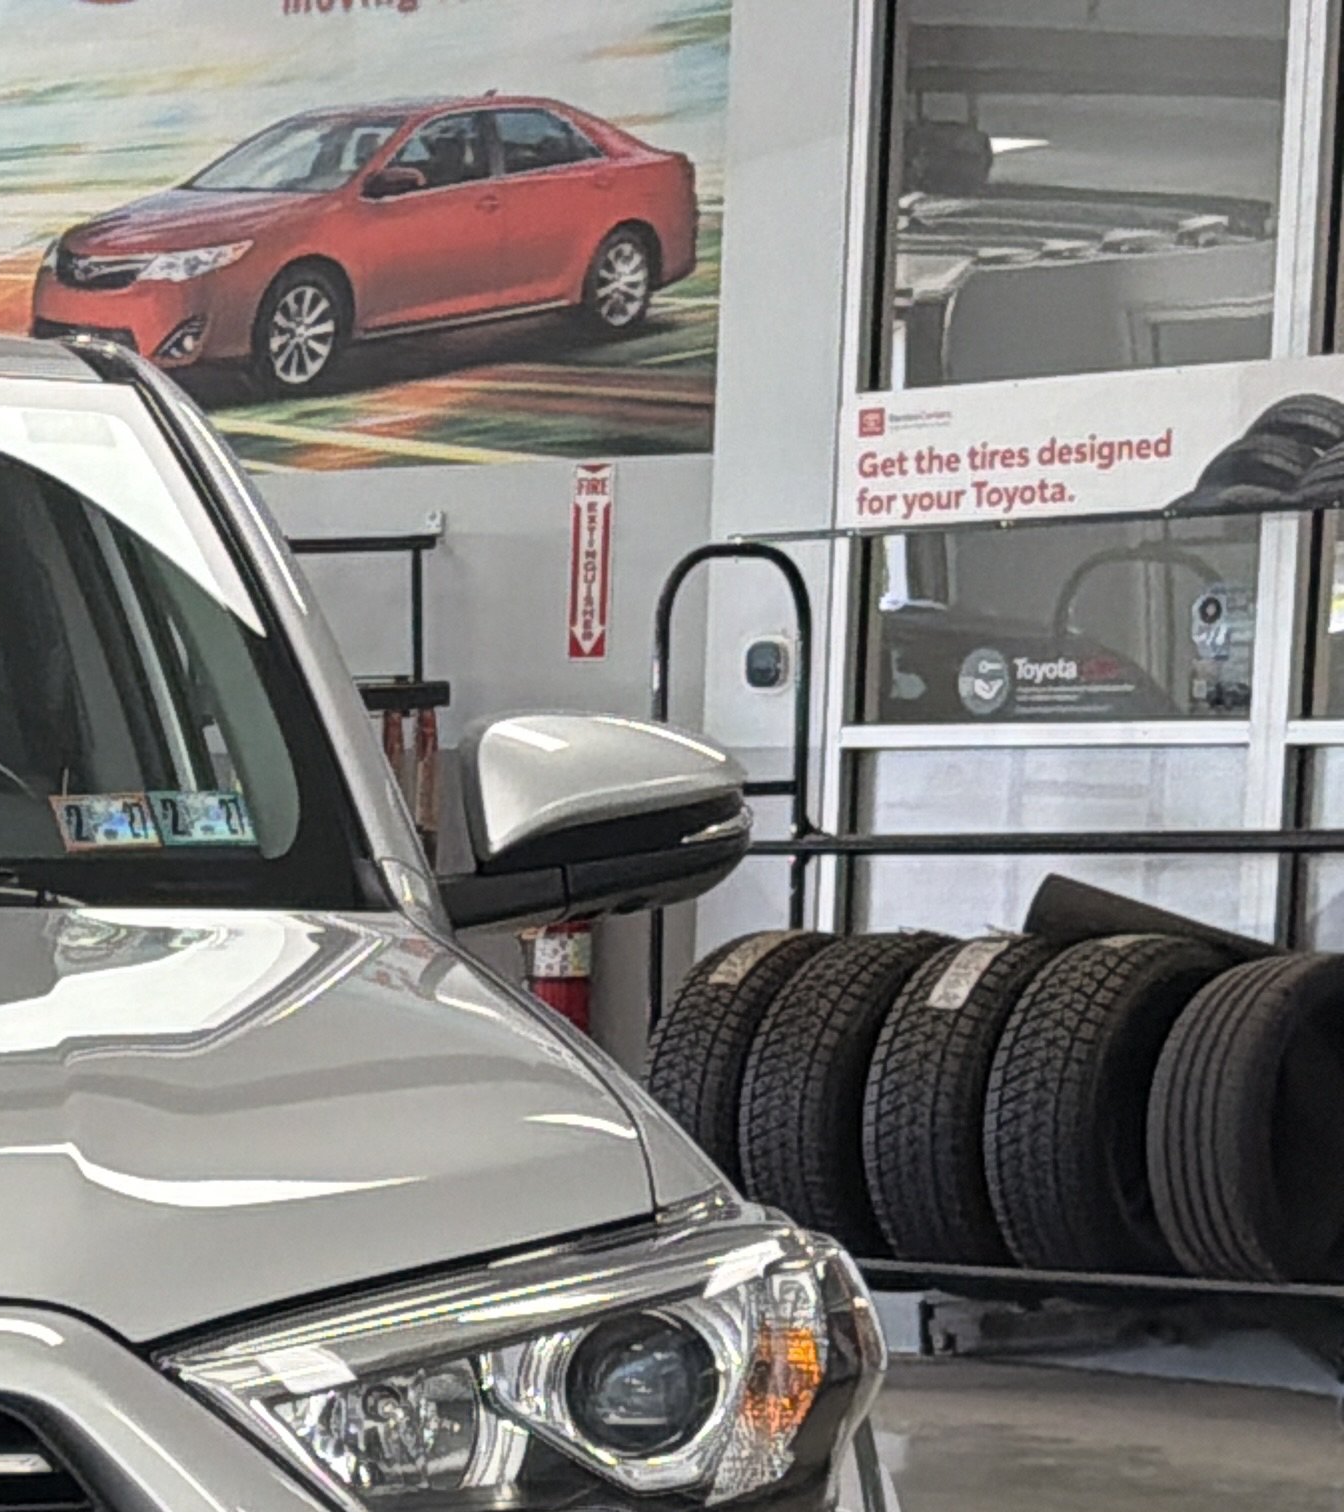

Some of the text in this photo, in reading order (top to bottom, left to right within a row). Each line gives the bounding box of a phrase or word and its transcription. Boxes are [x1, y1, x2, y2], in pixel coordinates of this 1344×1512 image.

[858, 427, 1173, 478] Get the tires designed
[577, 477, 609, 496] FIRE
[856, 479, 1076, 519] for your Toyota.
[1013, 657, 1078, 683] Toyota
